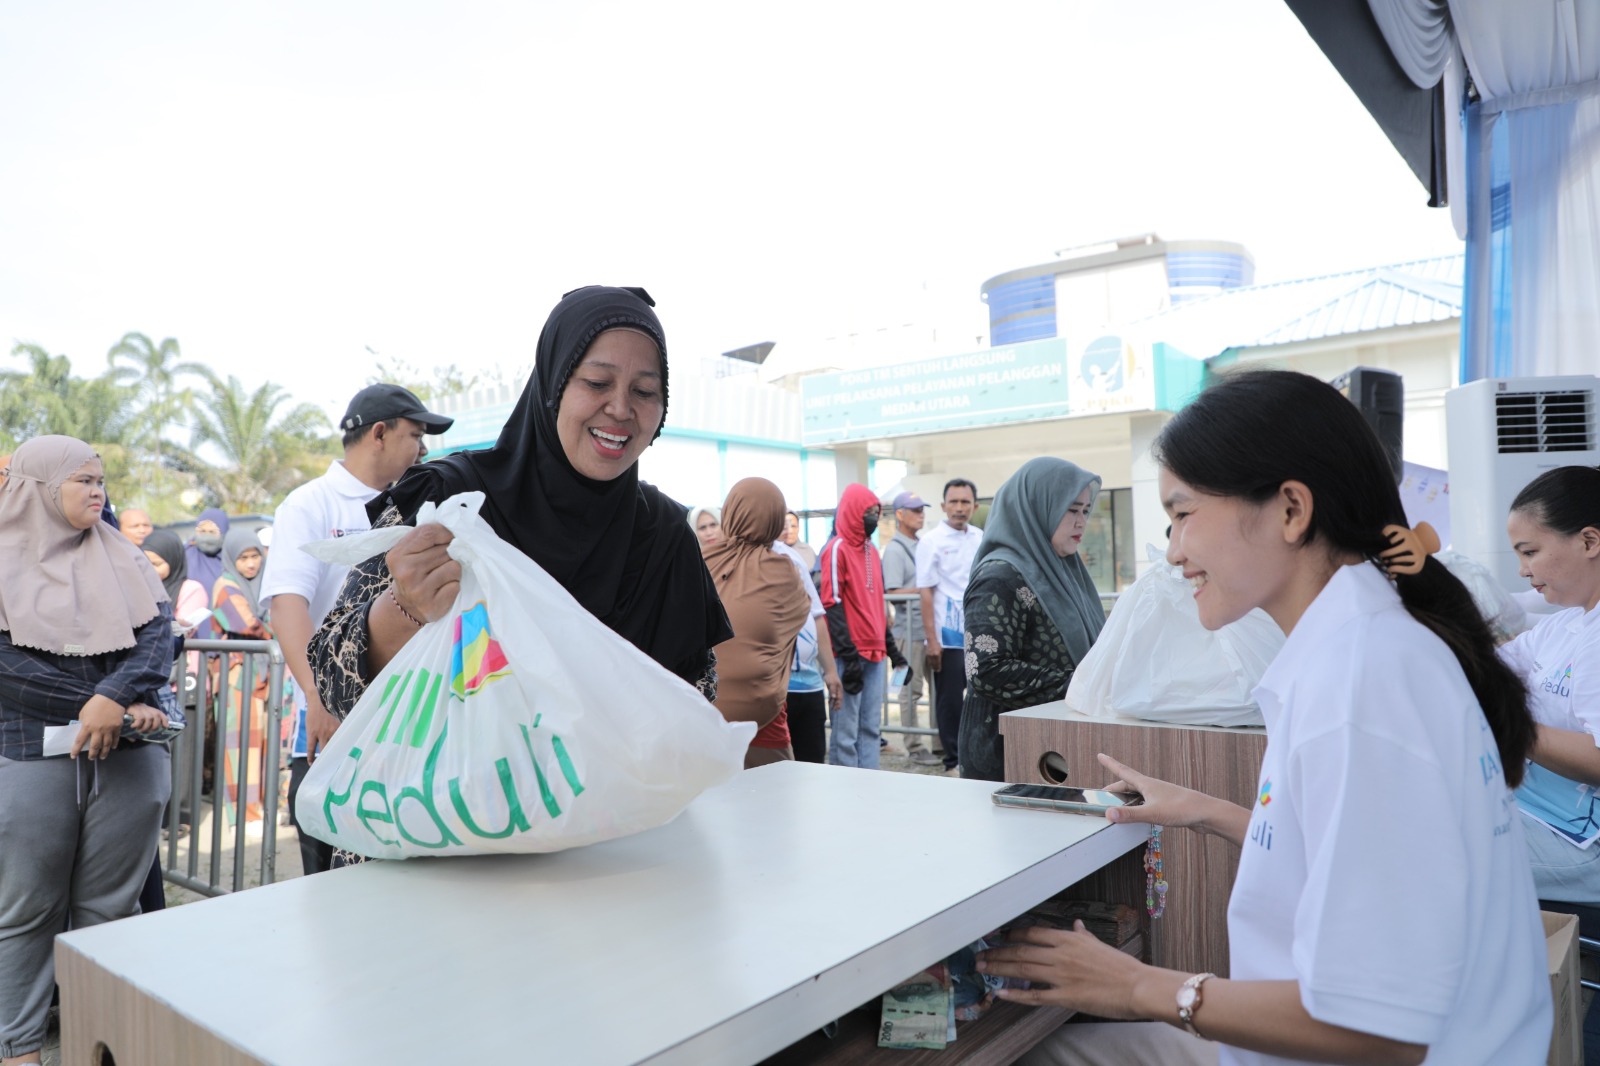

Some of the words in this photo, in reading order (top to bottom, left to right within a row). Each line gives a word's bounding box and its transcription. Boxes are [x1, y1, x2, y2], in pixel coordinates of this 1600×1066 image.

[893, 361, 940, 377] SENTUH
[943, 350, 1016, 371] LANGSUNG
[805, 395, 832, 410] UNIT
[833, 384, 901, 405] PELAKSANA
[902, 374, 976, 396] PELAYANAN
[978, 362, 1062, 386] PELANGGAN
[881, 398, 926, 417] MEDAN
[927, 394, 971, 412] UTARA
[1540, 674, 1570, 698] Pedu
